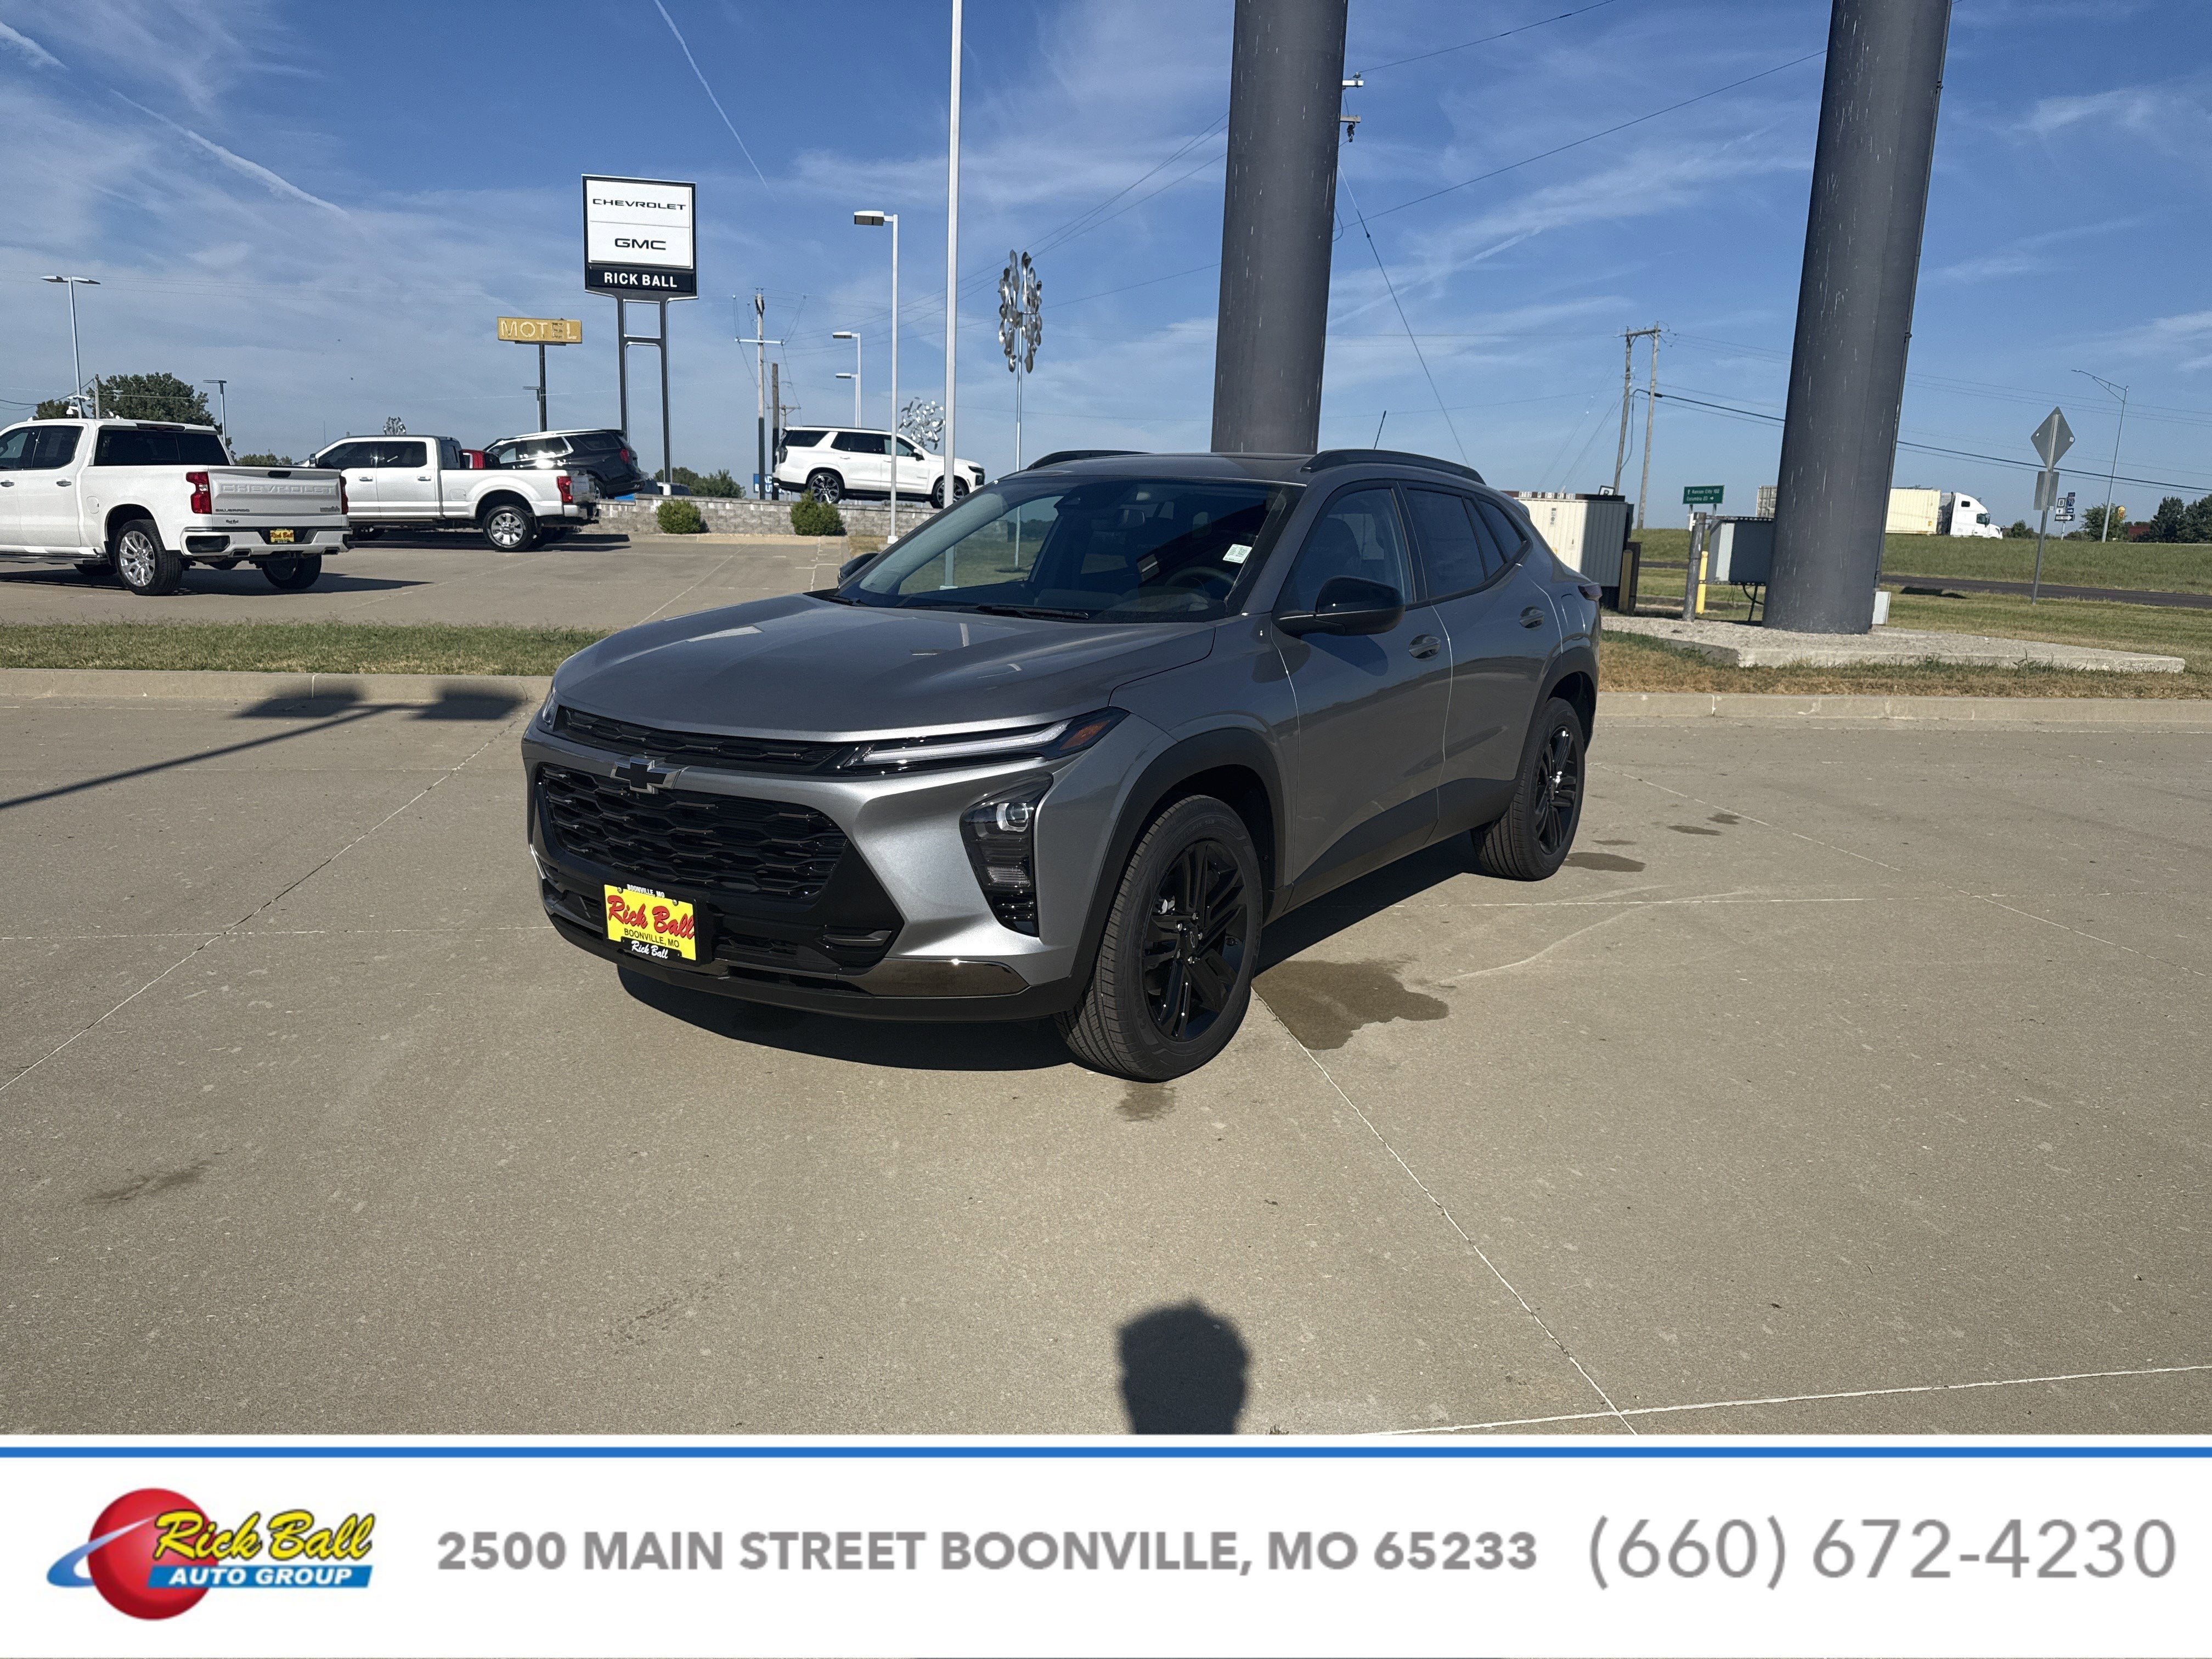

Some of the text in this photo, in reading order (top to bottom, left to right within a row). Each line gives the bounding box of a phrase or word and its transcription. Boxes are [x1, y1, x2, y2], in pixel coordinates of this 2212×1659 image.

[592, 199, 686, 210] CHEVROLET
[614, 238, 666, 250] GMC
[604, 272, 677, 287] RICK BALL
[501, 320, 577, 340] MOTEL
[221, 484, 334, 493] CHEVROLET
[627, 884, 656, 897] BOONVILLE,
[607, 895, 695, 940] Rick Ball
[624, 928, 680, 948] BOONVILLE, MO
[631, 940, 669, 959] Rick Ball
